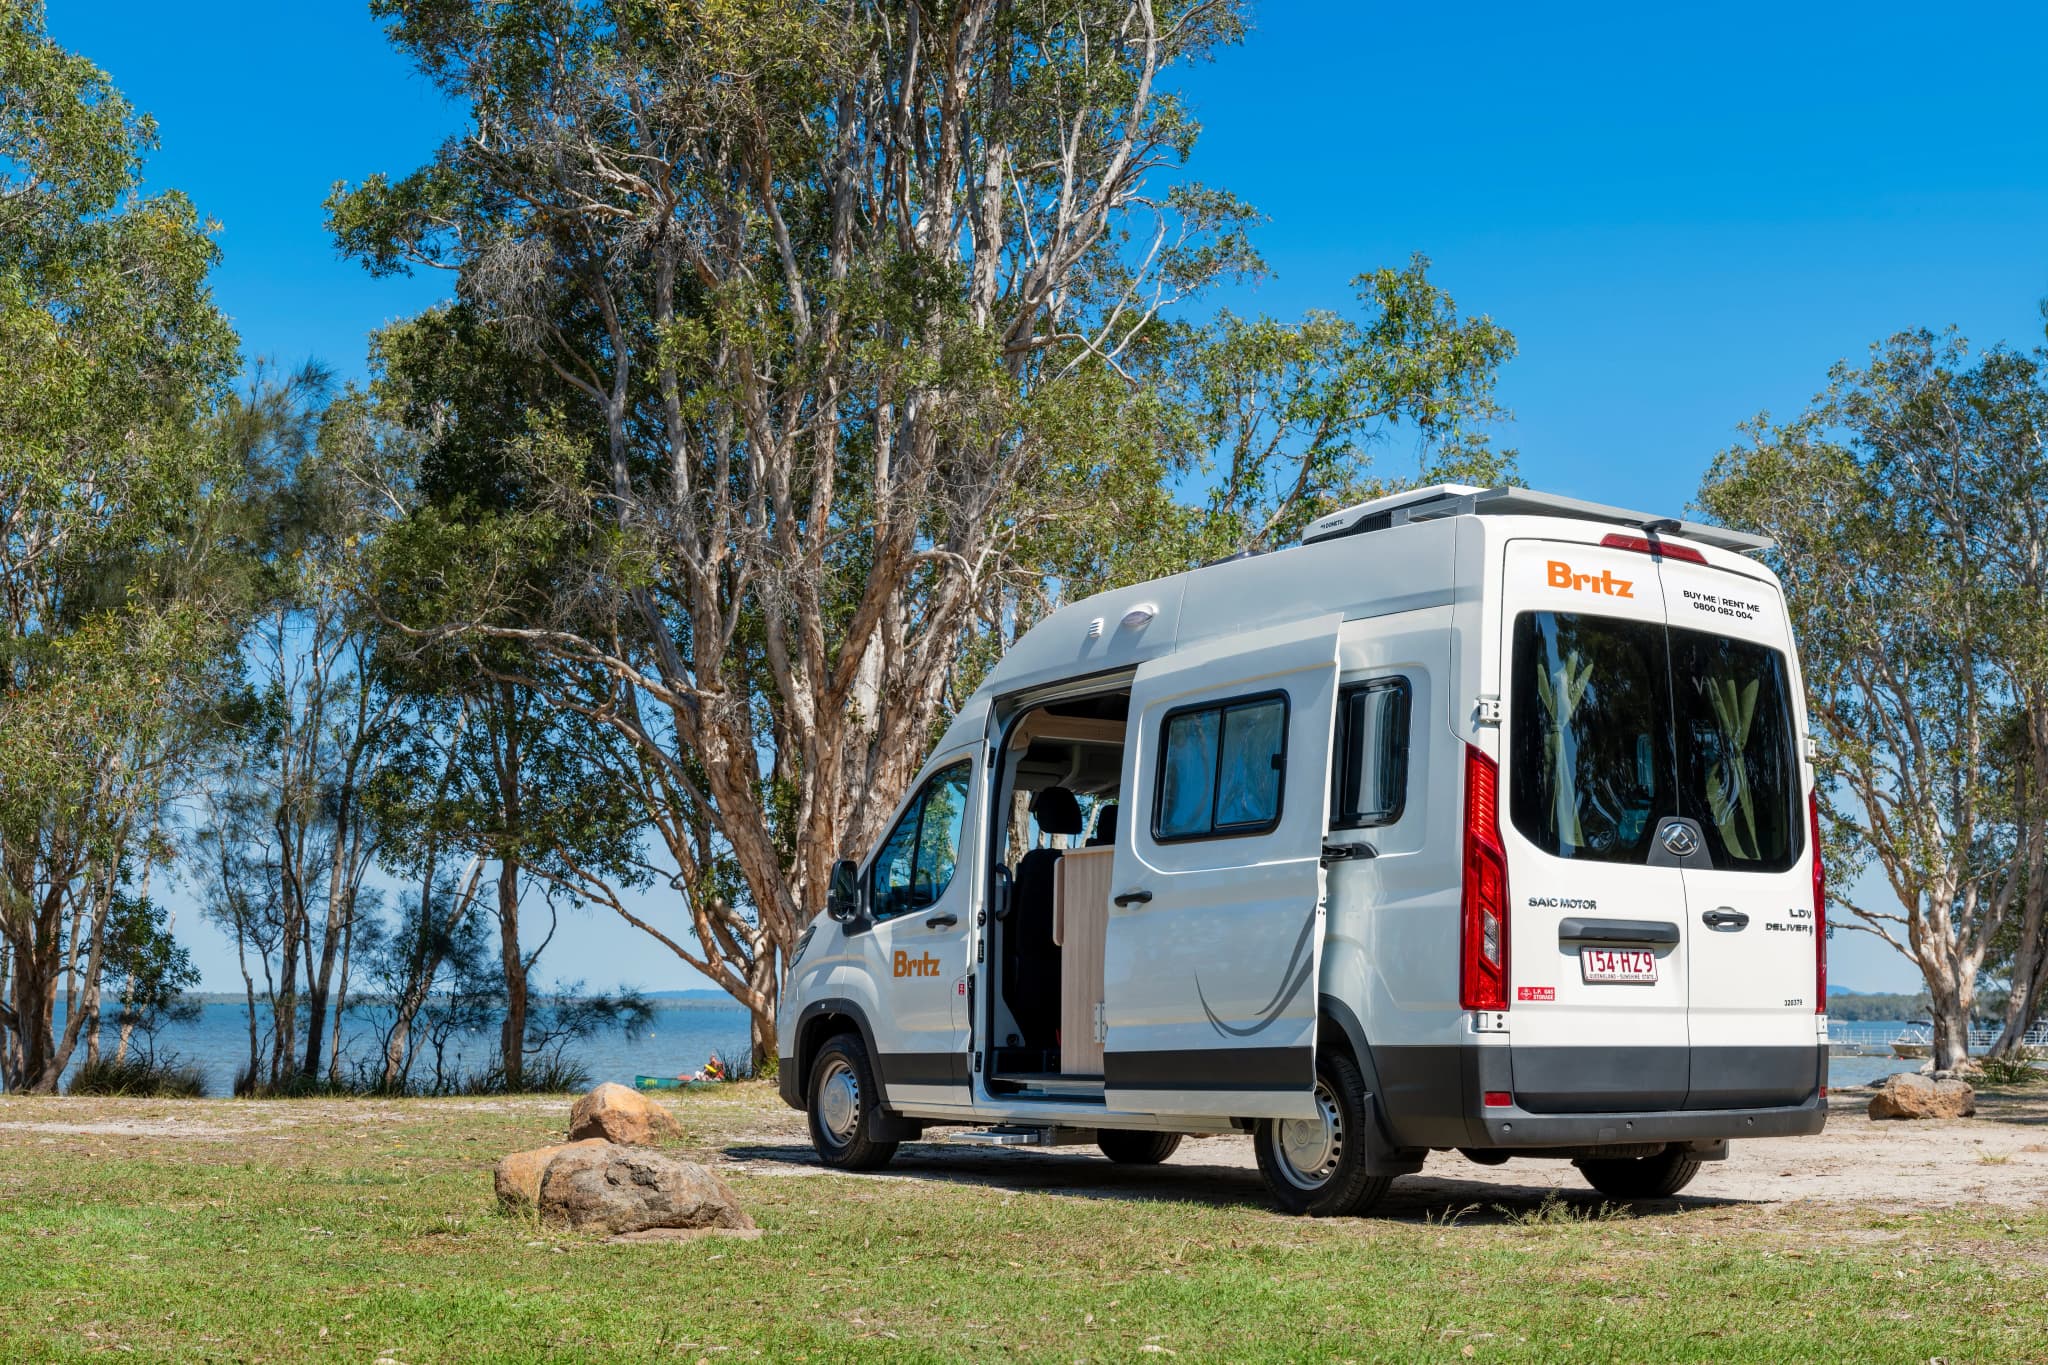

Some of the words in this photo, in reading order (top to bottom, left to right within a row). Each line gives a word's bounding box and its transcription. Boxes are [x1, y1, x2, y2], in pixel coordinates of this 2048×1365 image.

[1547, 560, 1634, 599] Britz
[1683, 590, 1701, 600] BUY
[1703, 594, 1717, 604] ME
[1722, 598, 1744, 609] RENT
[1746, 603, 1760, 612] ME
[1693, 601, 1716, 612] 0800
[1717, 606, 1734, 616] 082
[1735, 610, 1753, 620] 004
[1528, 897, 1558, 908] SAIC
[1559, 898, 1597, 910] MOTOR
[1765, 922, 1808, 932] DELIVER
[893, 950, 941, 977] Britz
